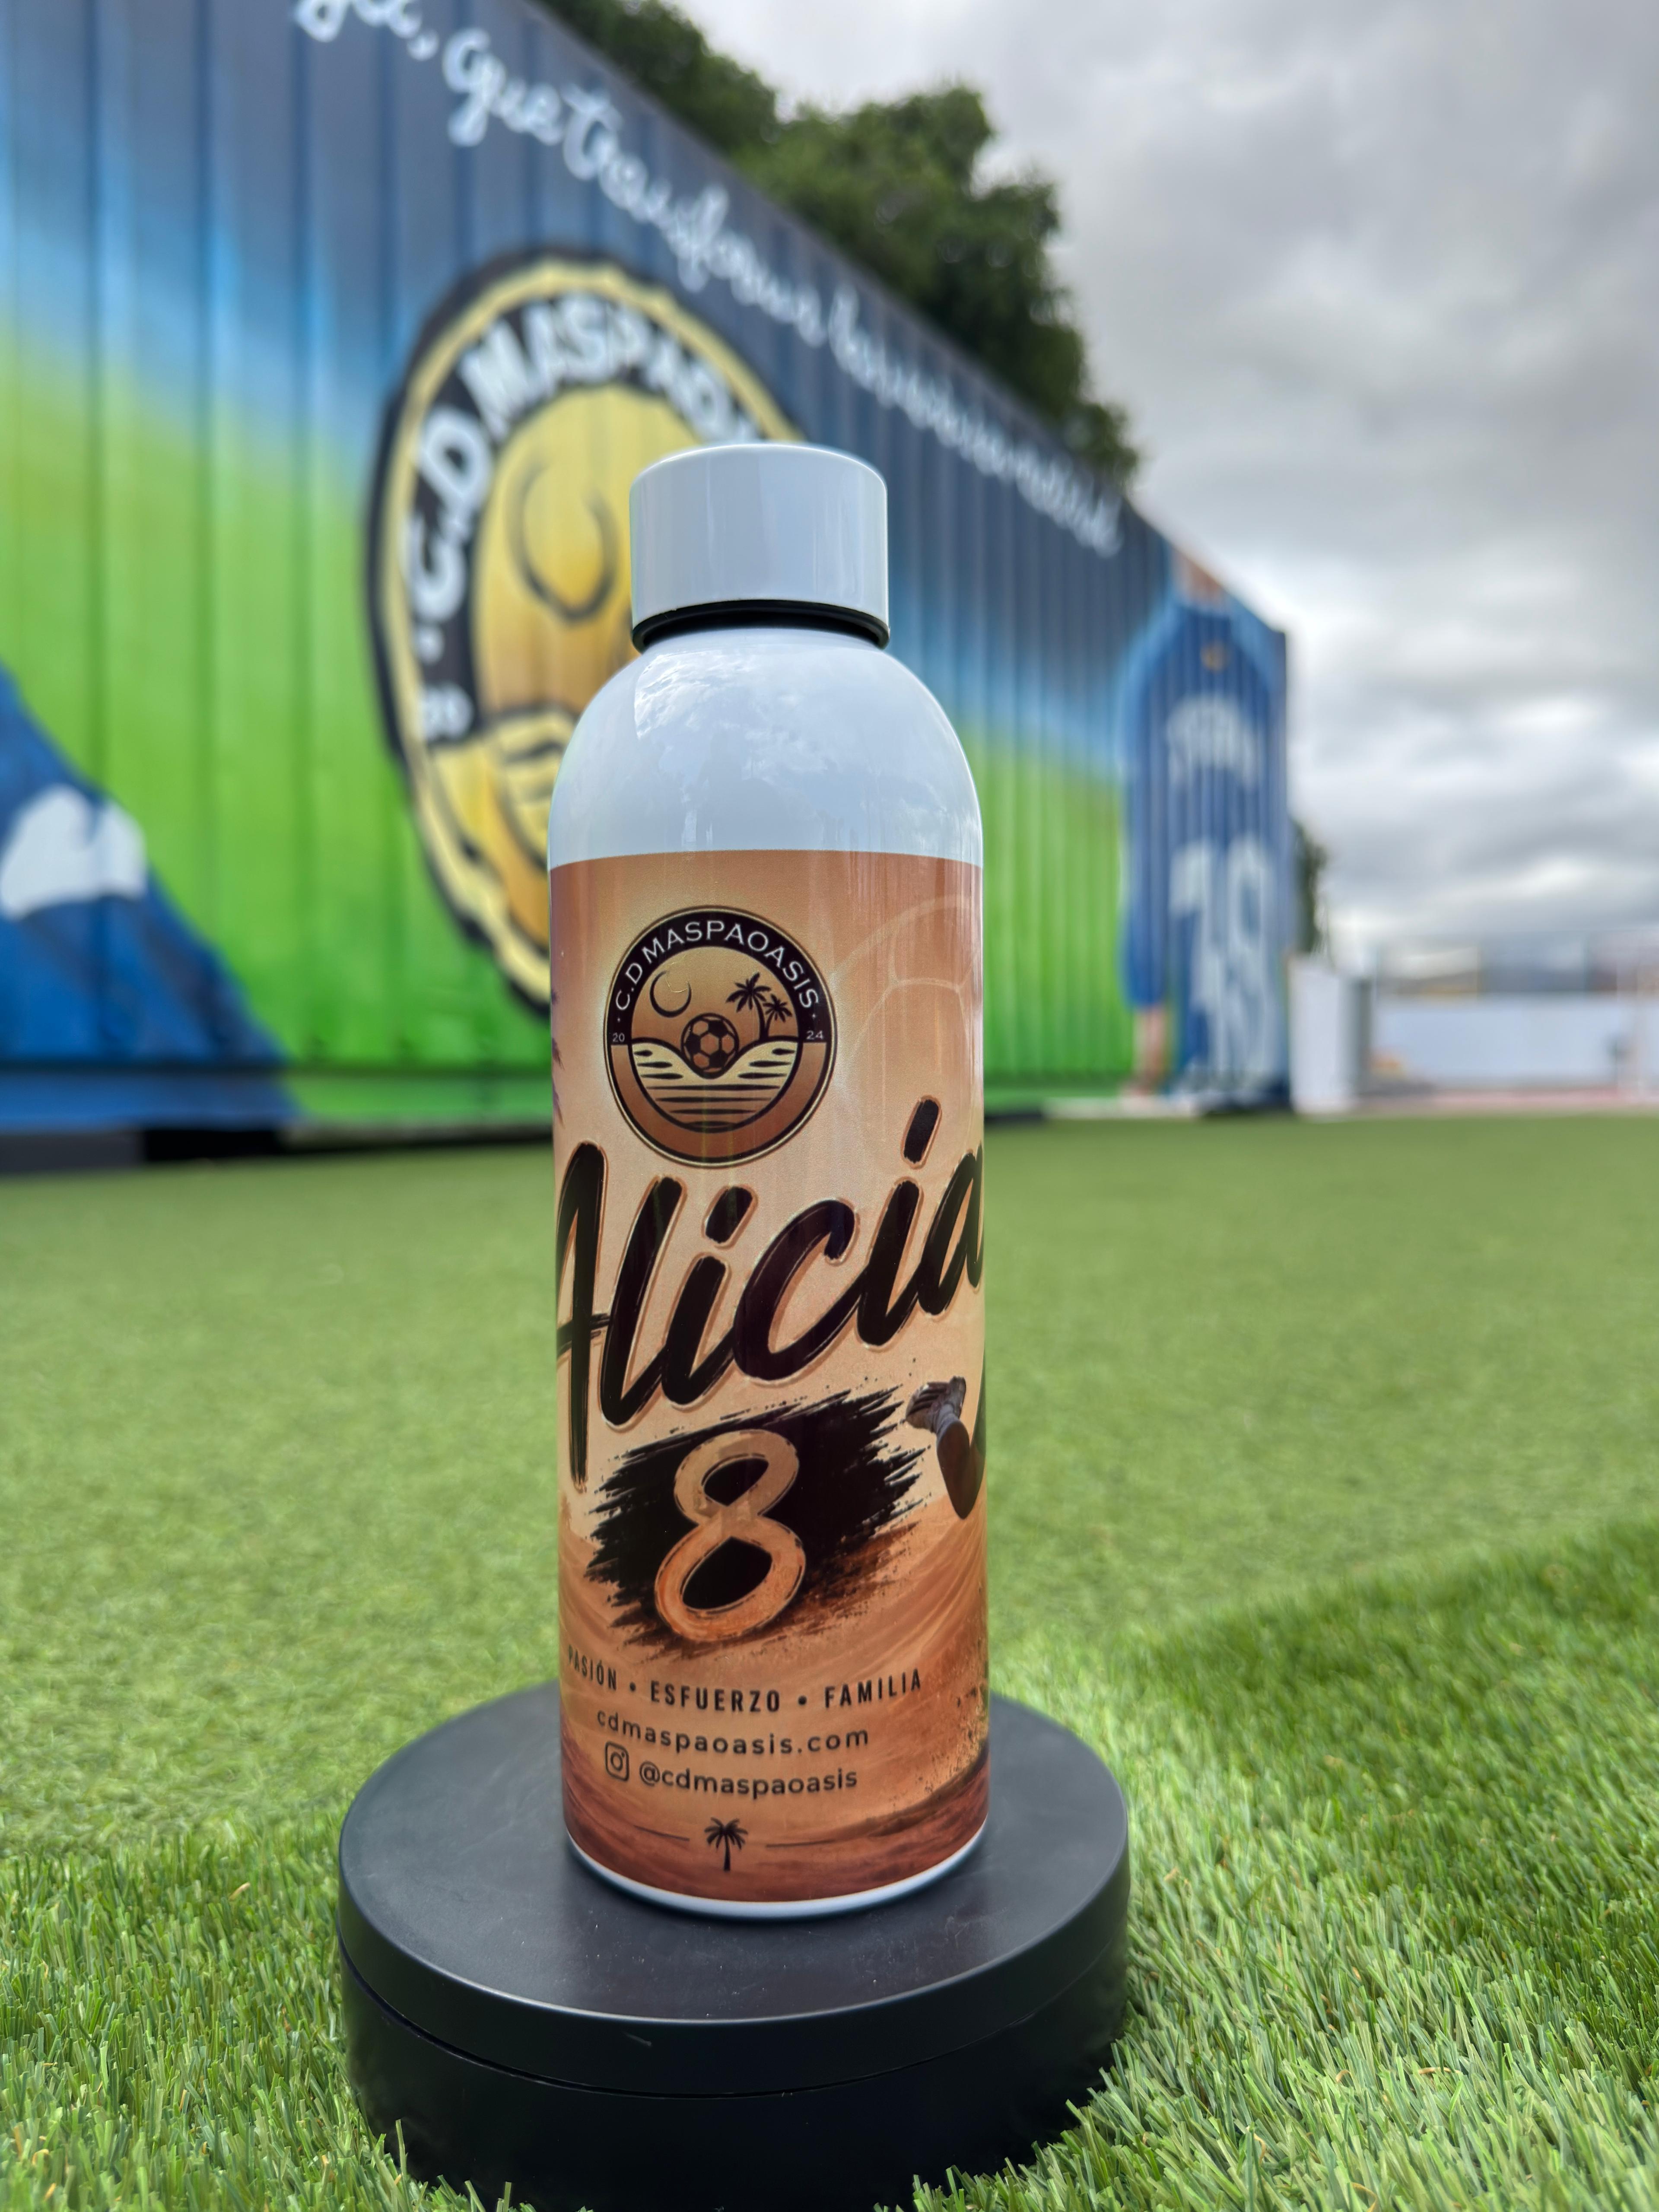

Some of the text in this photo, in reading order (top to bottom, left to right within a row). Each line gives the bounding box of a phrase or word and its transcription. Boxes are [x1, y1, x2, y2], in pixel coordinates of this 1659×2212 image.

[460, 294, 763, 443] MASPAO
[642, 920, 820, 1008] MASPAOASIS
[613, 1032, 625, 1042] 20
[806, 1030, 823, 1040] 24
[556, 1096, 984, 1491] Alicia
[653, 1428, 807, 1642] 8
[568, 1643, 921, 1713] PASIÓN ESFUERZO FAMILIA
[597, 1710, 869, 1754] cdmaspaoasis.com
[639, 1761, 858, 1800] @cdmaspaoasis
